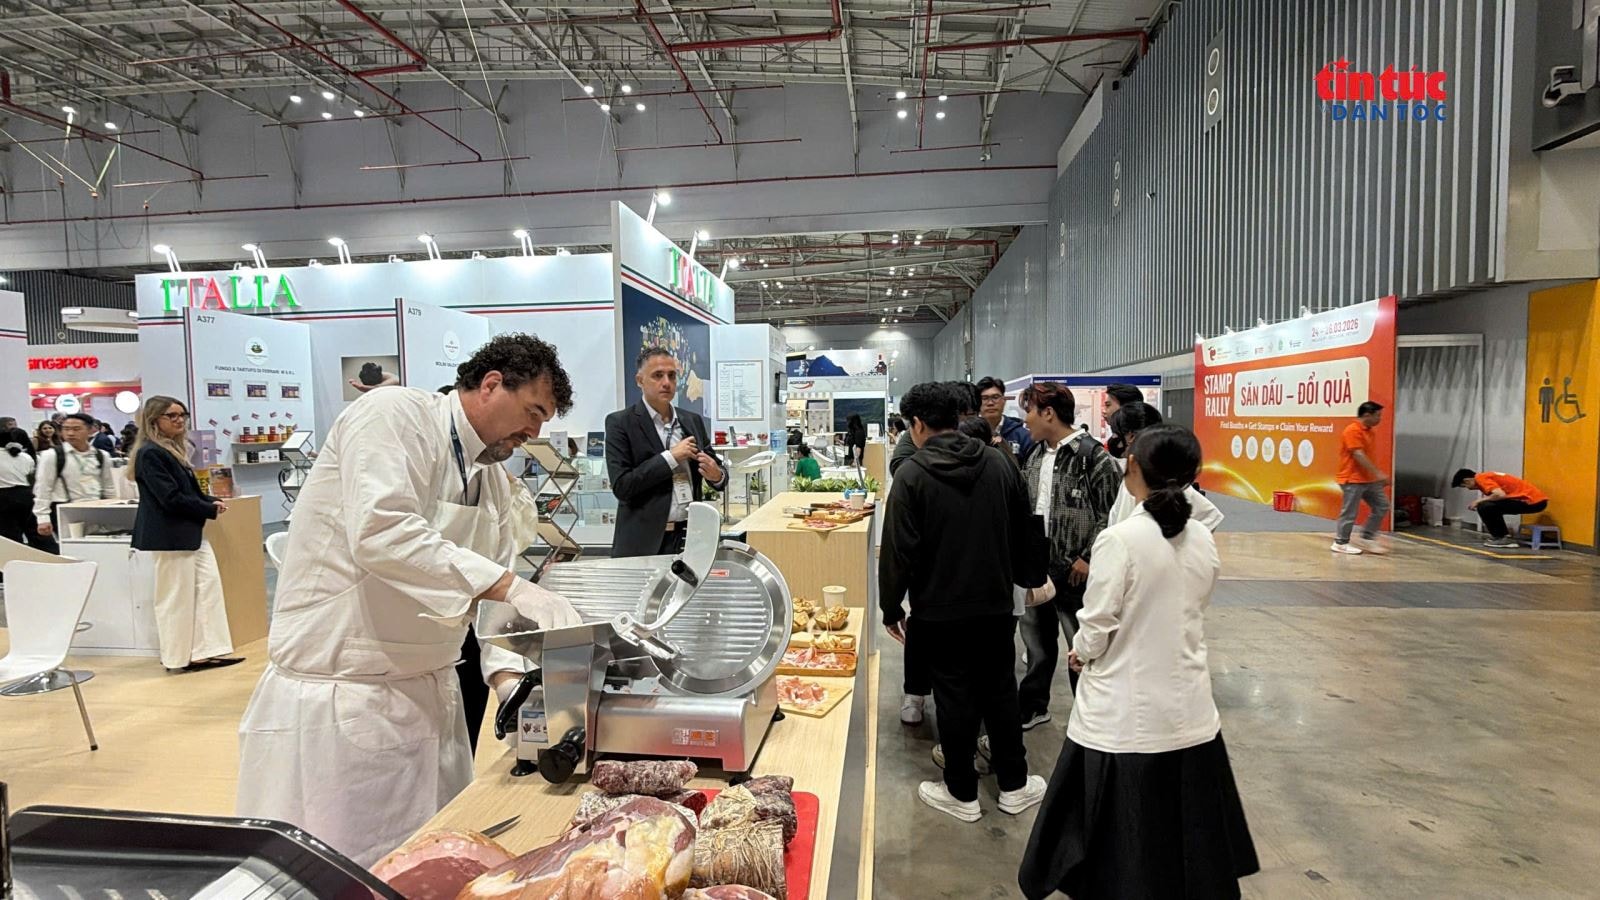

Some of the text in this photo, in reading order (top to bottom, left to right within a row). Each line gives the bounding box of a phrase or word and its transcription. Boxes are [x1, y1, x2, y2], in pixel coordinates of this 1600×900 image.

[160, 274, 301, 311] ITALIA
[197, 315, 215, 324] A377
[1204, 372, 1233, 395] STAMP
[1241, 381, 1259, 406] SĂN
[1262, 376, 1283, 406] DẤU
[1298, 371, 1319, 405] ĐỔI
[1323, 371, 1353, 407] QUÀ
[1205, 396, 1231, 417] RALLY
[1280, 422, 1296, 432] Claim
[1296, 422, 1309, 433] Your
[1309, 423, 1334, 433] Reward
